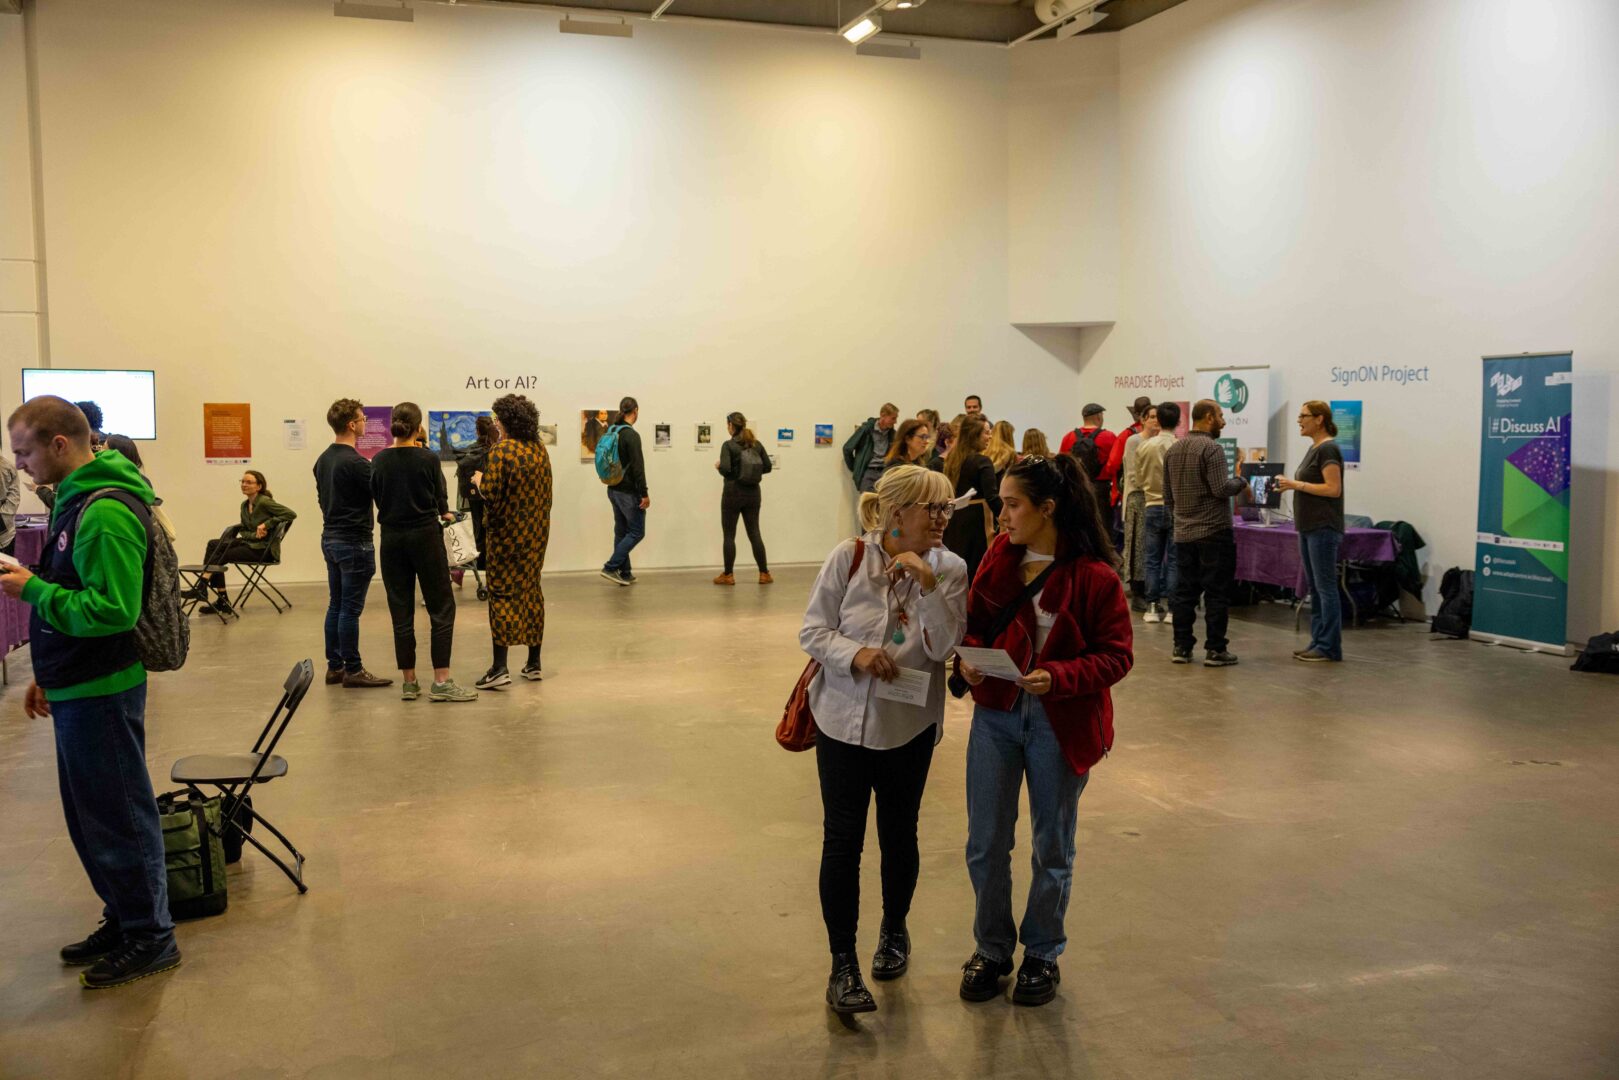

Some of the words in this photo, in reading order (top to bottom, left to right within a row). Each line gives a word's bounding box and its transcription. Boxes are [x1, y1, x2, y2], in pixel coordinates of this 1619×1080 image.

[465, 376, 490, 389] Art
[494, 379, 510, 389] or
[514, 376, 538, 389] AI?
[1114, 375, 1152, 388] PARADISE
[1154, 375, 1185, 391] Project
[1331, 366, 1378, 386] SignON
[1382, 365, 1429, 386] Project
